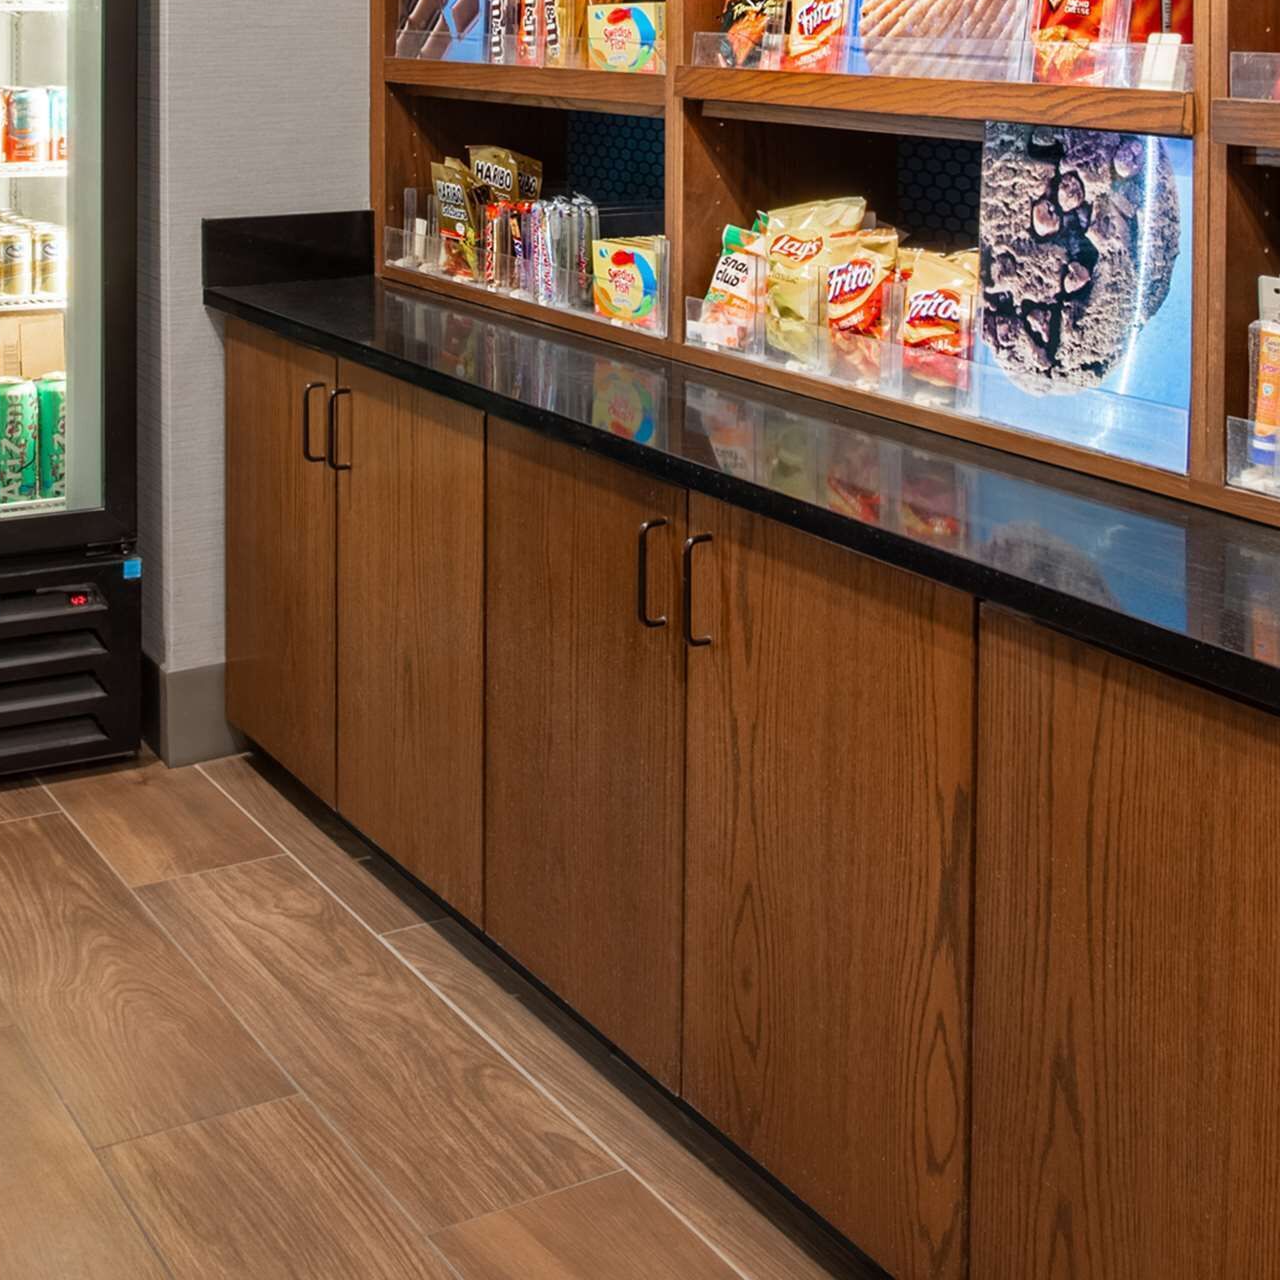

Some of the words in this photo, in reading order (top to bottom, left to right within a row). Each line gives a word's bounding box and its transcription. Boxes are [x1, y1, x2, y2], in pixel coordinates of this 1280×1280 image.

[797, 0, 842, 35] Fritos
[603, 26, 633, 43] Swedish
[609, 39, 627, 52] Fish
[475, 160, 514, 192] HARIBO
[437, 179, 465, 205] HARIBO
[772, 234, 822, 260] Lay's
[608, 268, 636, 285] Swedish
[614, 281, 630, 295] Fish
[715, 268, 740, 287] club
[829, 263, 873, 300] Fritos
[908, 290, 961, 322] Fritos
